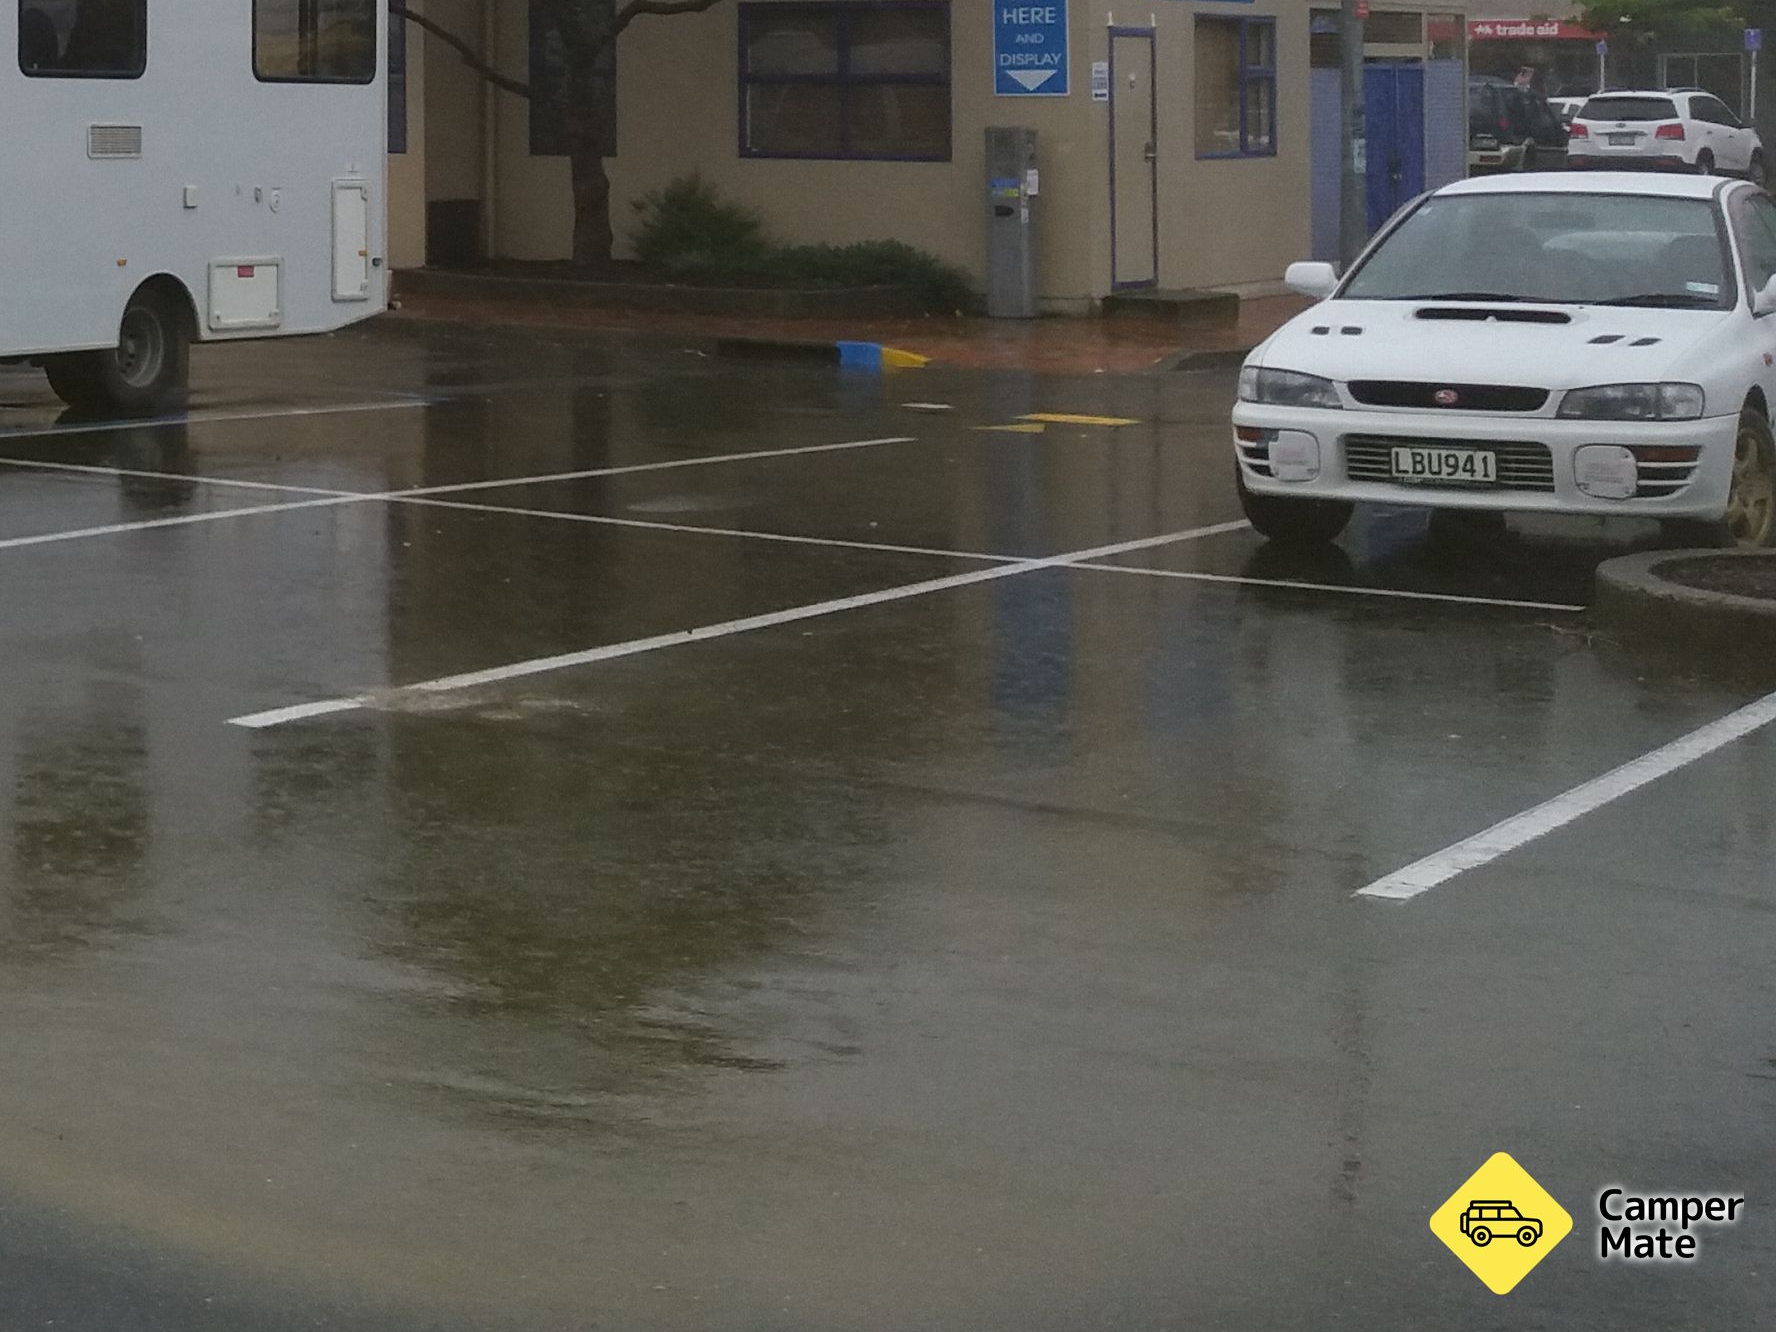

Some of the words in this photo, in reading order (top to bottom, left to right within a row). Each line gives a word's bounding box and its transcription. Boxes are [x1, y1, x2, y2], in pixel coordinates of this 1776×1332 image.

[1002, 7, 1056, 25] HERE
[1496, 22, 1534, 36] trade
[1536, 22, 1559, 36] aid
[1015, 33, 1045, 44] AND
[999, 53, 1062, 66] DISPLAY
[1394, 451, 1491, 479] LBU941
